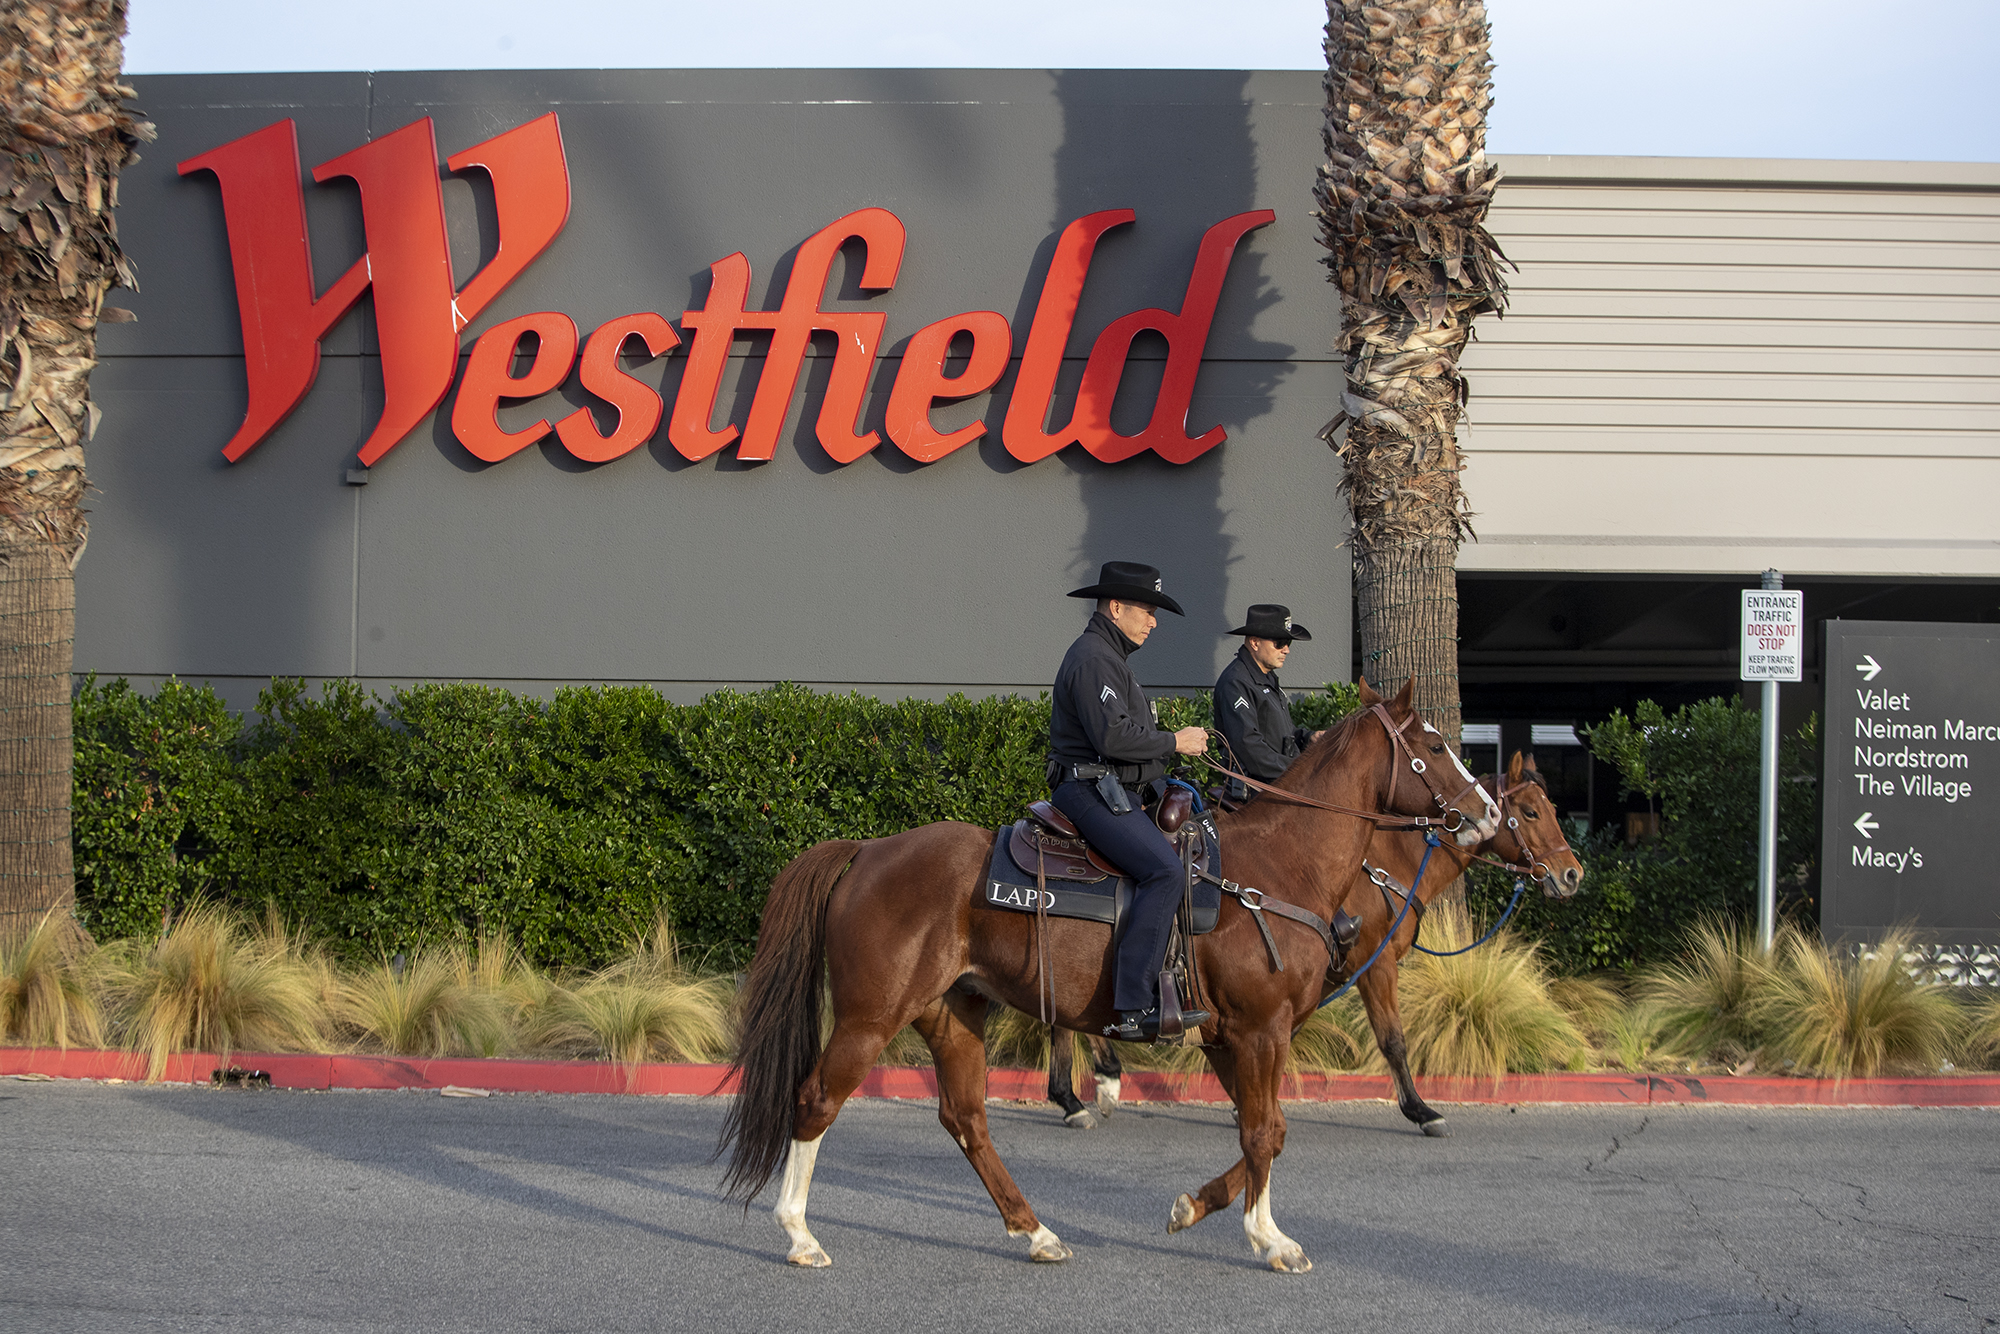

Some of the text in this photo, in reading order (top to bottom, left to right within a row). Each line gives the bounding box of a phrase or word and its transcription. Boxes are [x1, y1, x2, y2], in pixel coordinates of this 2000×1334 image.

[177, 111, 1276, 467] Westfield
[1747, 596, 1797, 608] ENTRANCE
[1753, 610, 1792, 622] TRAFFIC
[1747, 624, 1797, 637] DOES NOT
[1758, 638, 1785, 650] STOP
[1748, 655, 1795, 664] KEEP TRAFFIC
[1748, 665, 1795, 674] FLOW MOVING
[1856, 688, 1911, 711] Valet
[1855, 717, 1937, 740] Neiman
[1854, 745, 1969, 769] Nordstrom
[1854, 773, 1972, 803] The Village
[1852, 845, 1923, 874] Macy's
[990, 882, 1056, 909] LAPD
